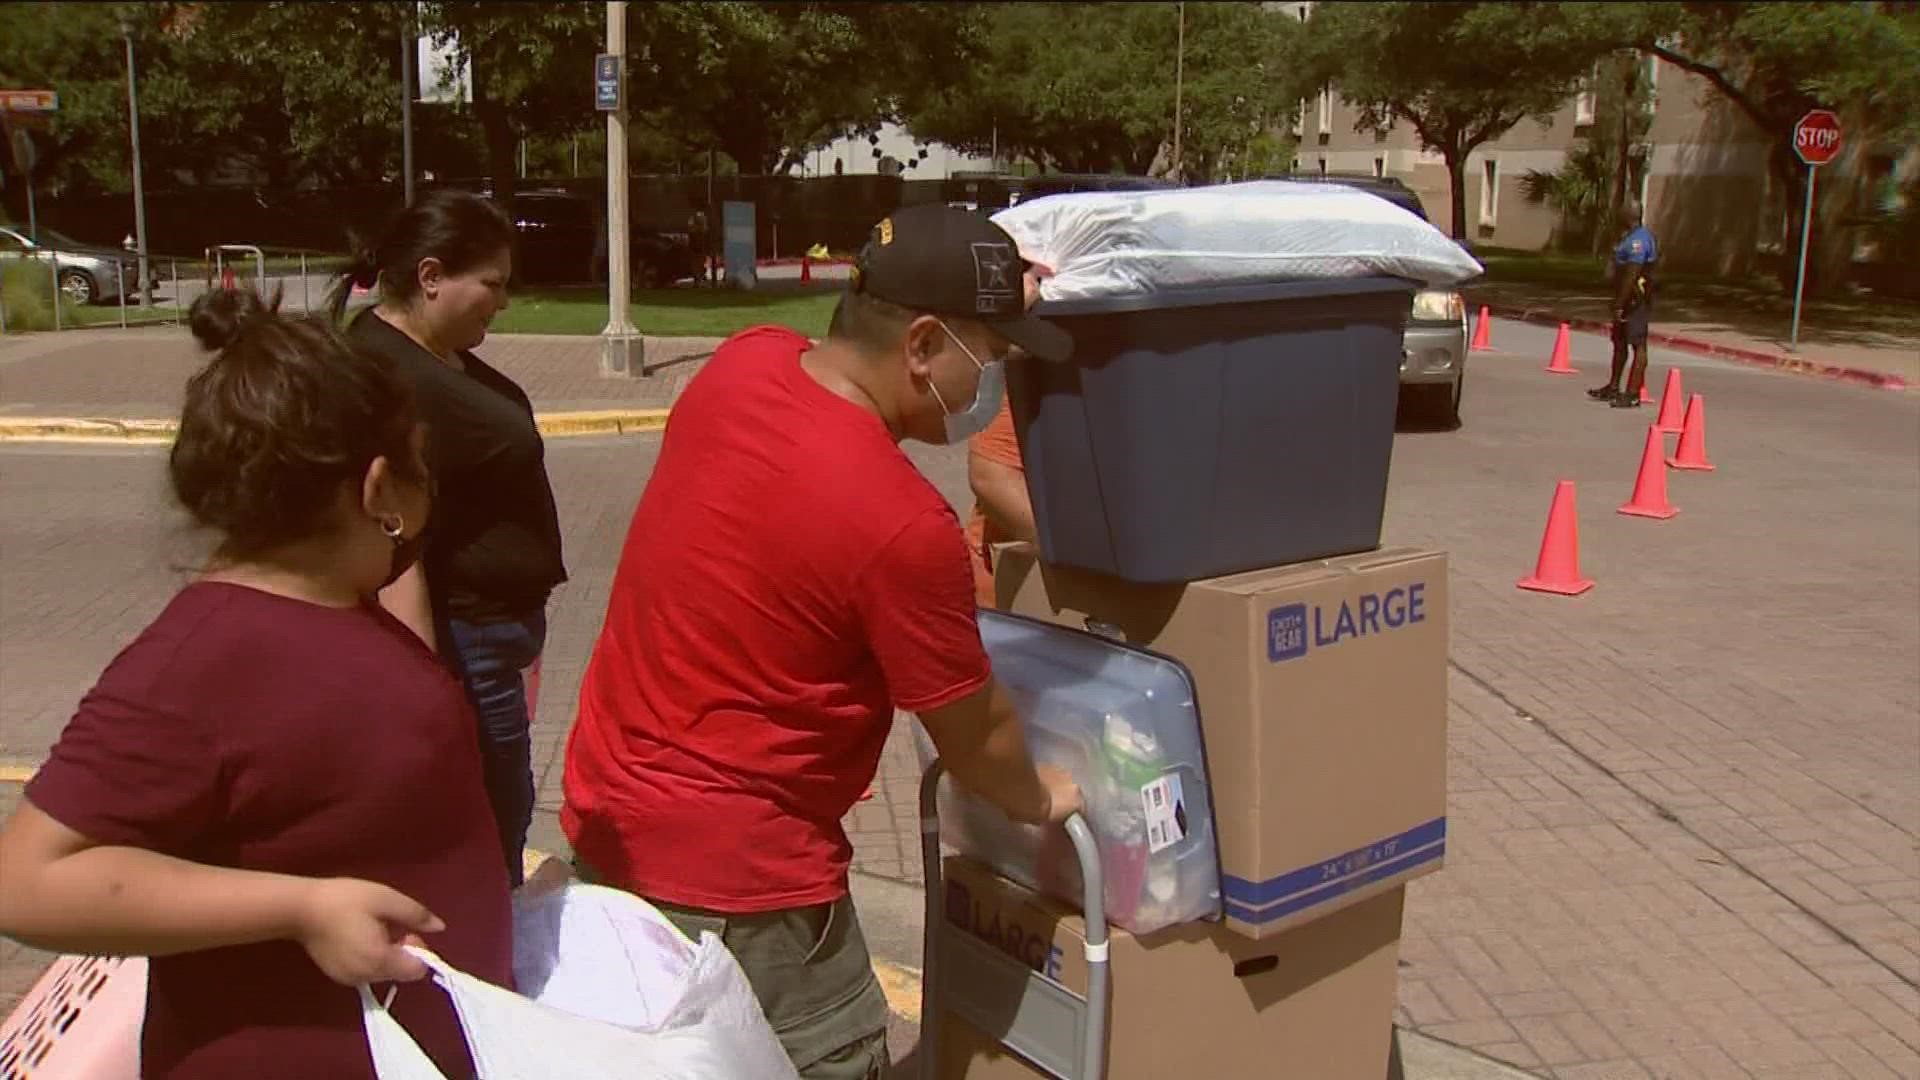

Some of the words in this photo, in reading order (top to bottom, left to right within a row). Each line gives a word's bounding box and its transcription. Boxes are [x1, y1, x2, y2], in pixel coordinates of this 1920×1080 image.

[1798, 127, 1839, 149] STOP
[1314, 582, 1425, 647] LARGE
[973, 898, 1064, 984] LARGE
